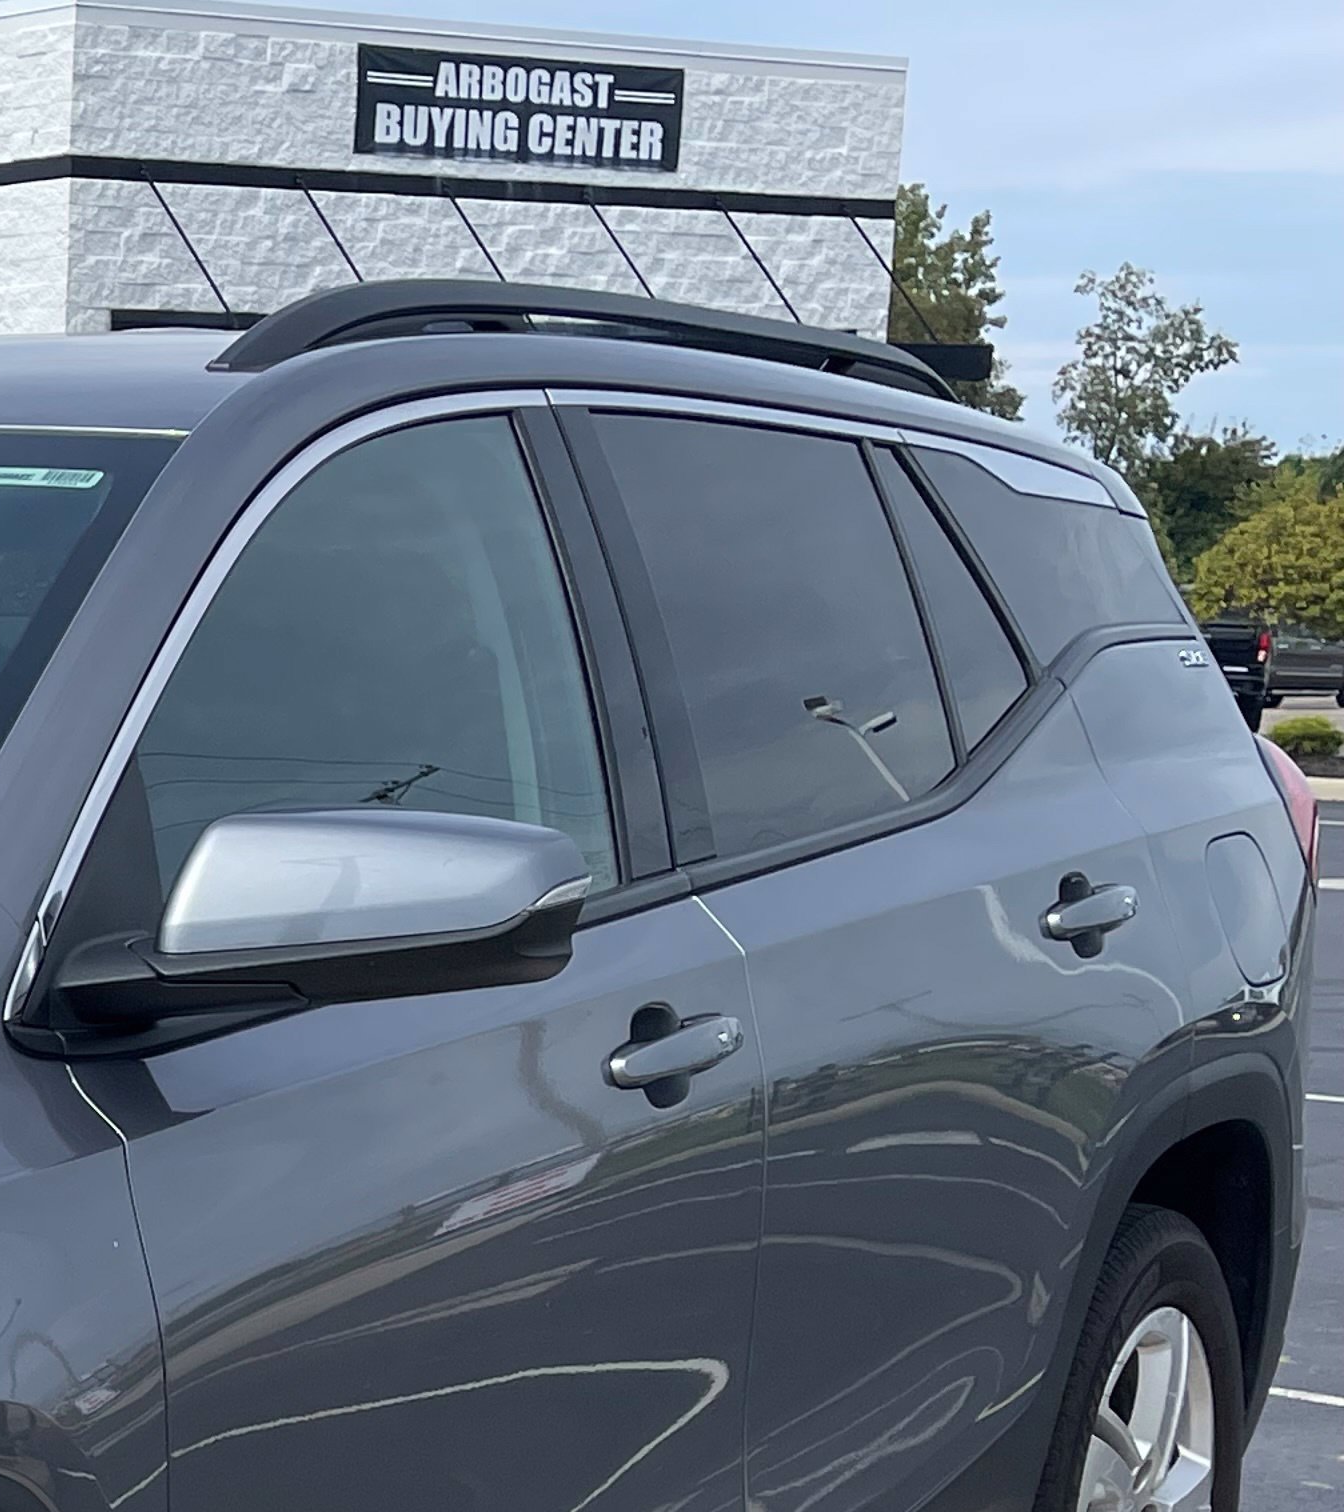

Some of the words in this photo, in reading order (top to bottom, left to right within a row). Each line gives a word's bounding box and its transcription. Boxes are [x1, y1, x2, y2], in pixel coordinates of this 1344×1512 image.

[434, 61, 615, 110] ARBOGAST
[373, 102, 520, 153] BUYING
[527, 112, 665, 161] CENTER
